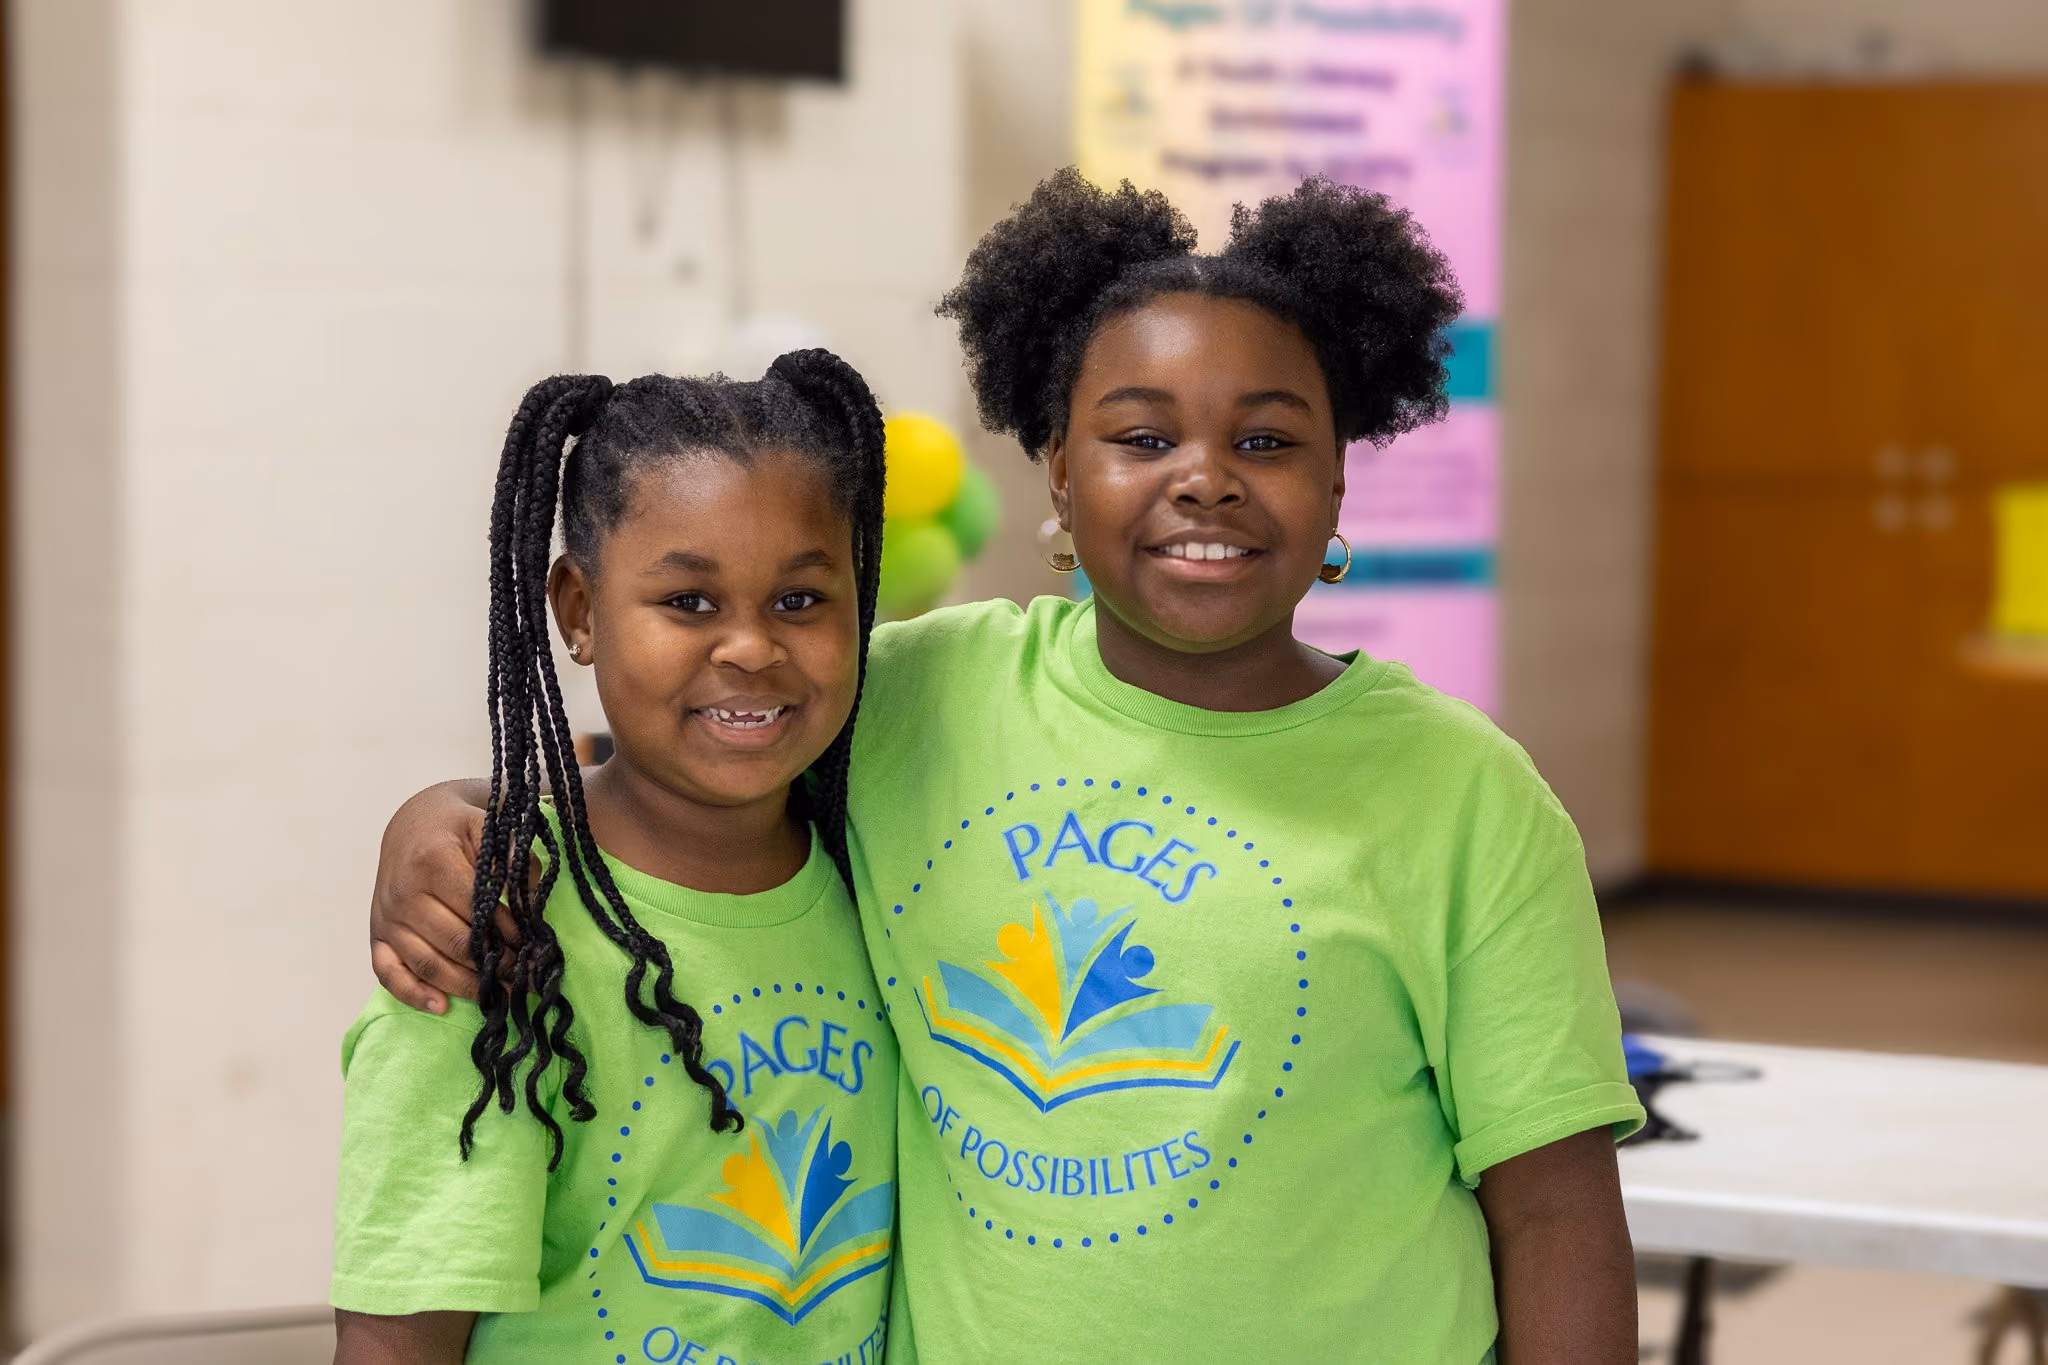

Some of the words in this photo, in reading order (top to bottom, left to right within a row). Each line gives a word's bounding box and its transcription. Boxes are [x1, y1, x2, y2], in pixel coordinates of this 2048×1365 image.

[1002, 810, 1219, 904] PAGES
[922, 1085, 960, 1137] OF
[960, 1130, 1211, 1197] POSSIBILITES
